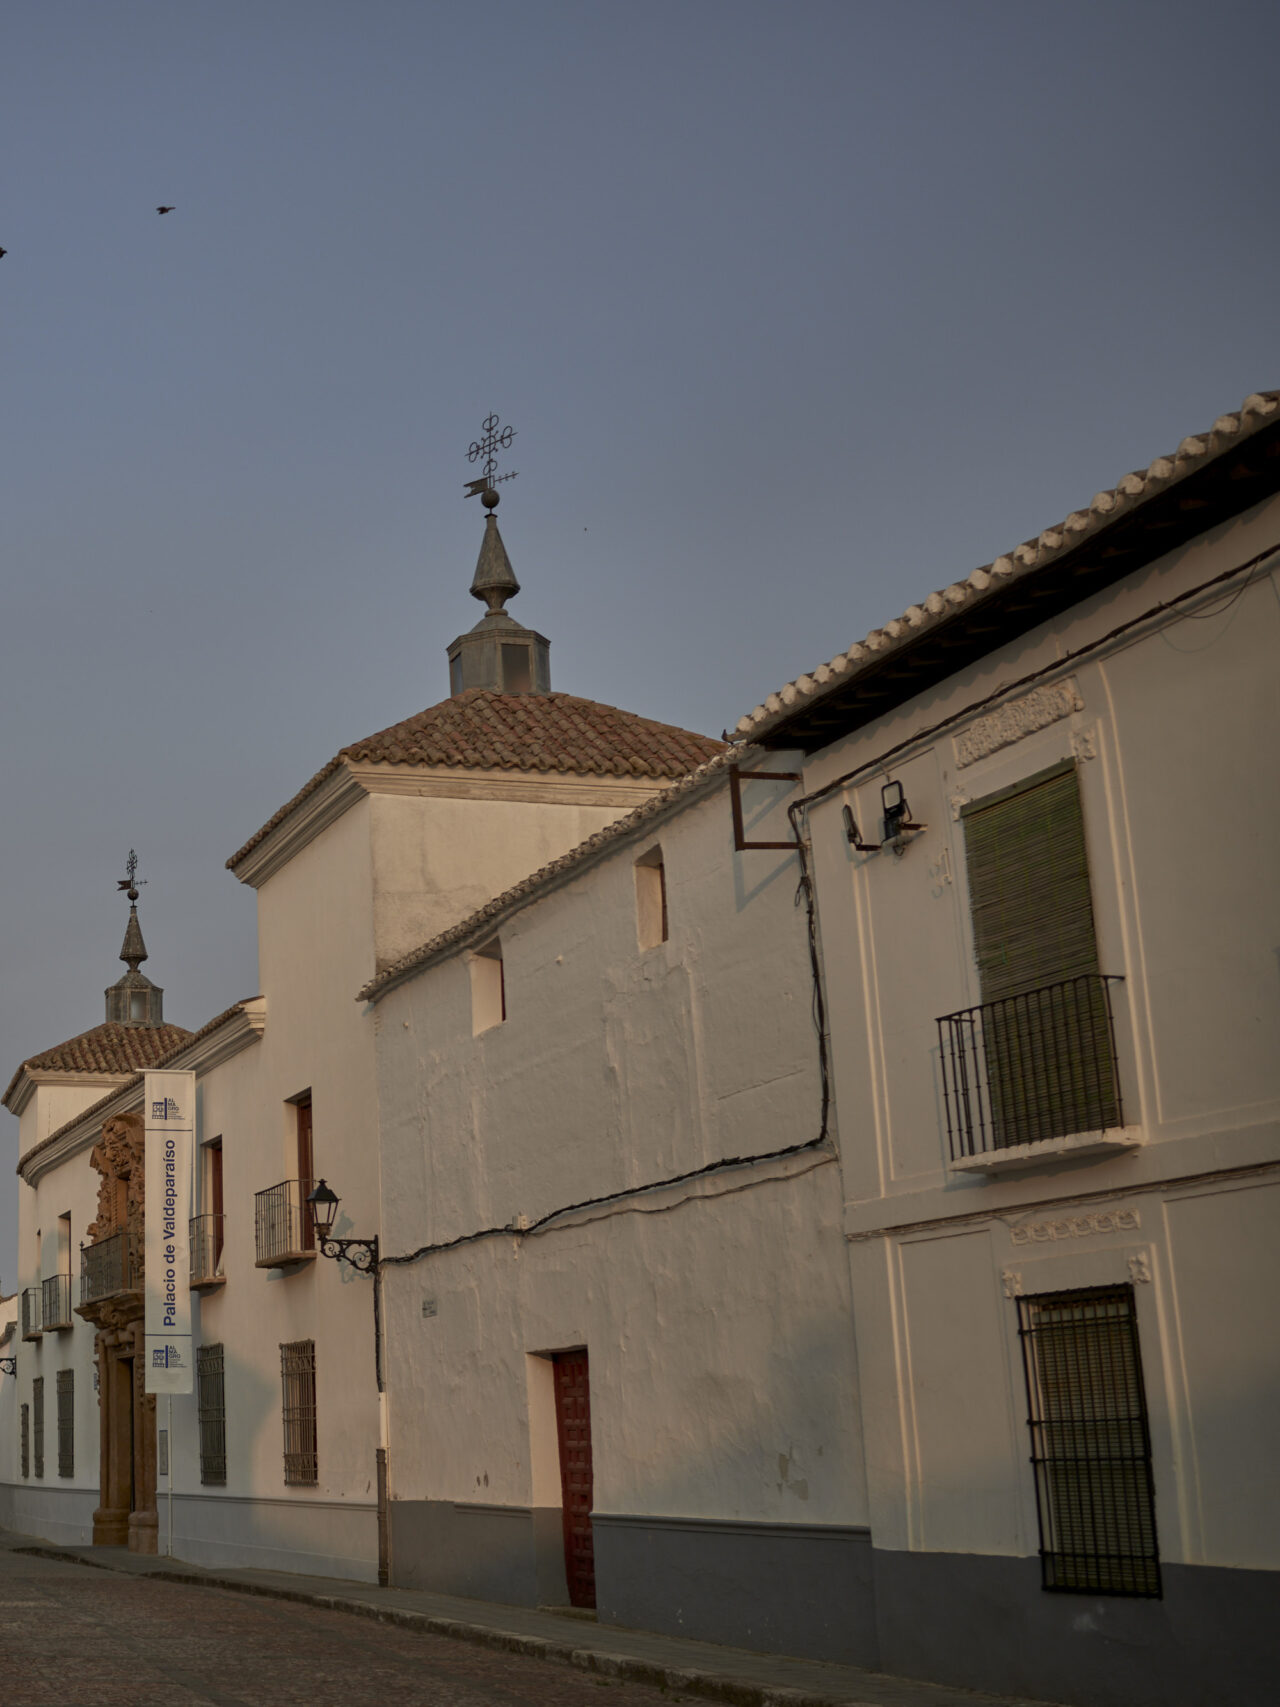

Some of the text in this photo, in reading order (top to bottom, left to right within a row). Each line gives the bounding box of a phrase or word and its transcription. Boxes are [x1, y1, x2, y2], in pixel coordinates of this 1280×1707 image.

[163, 1139, 178, 1327] Palacio de Valdeparaíso
